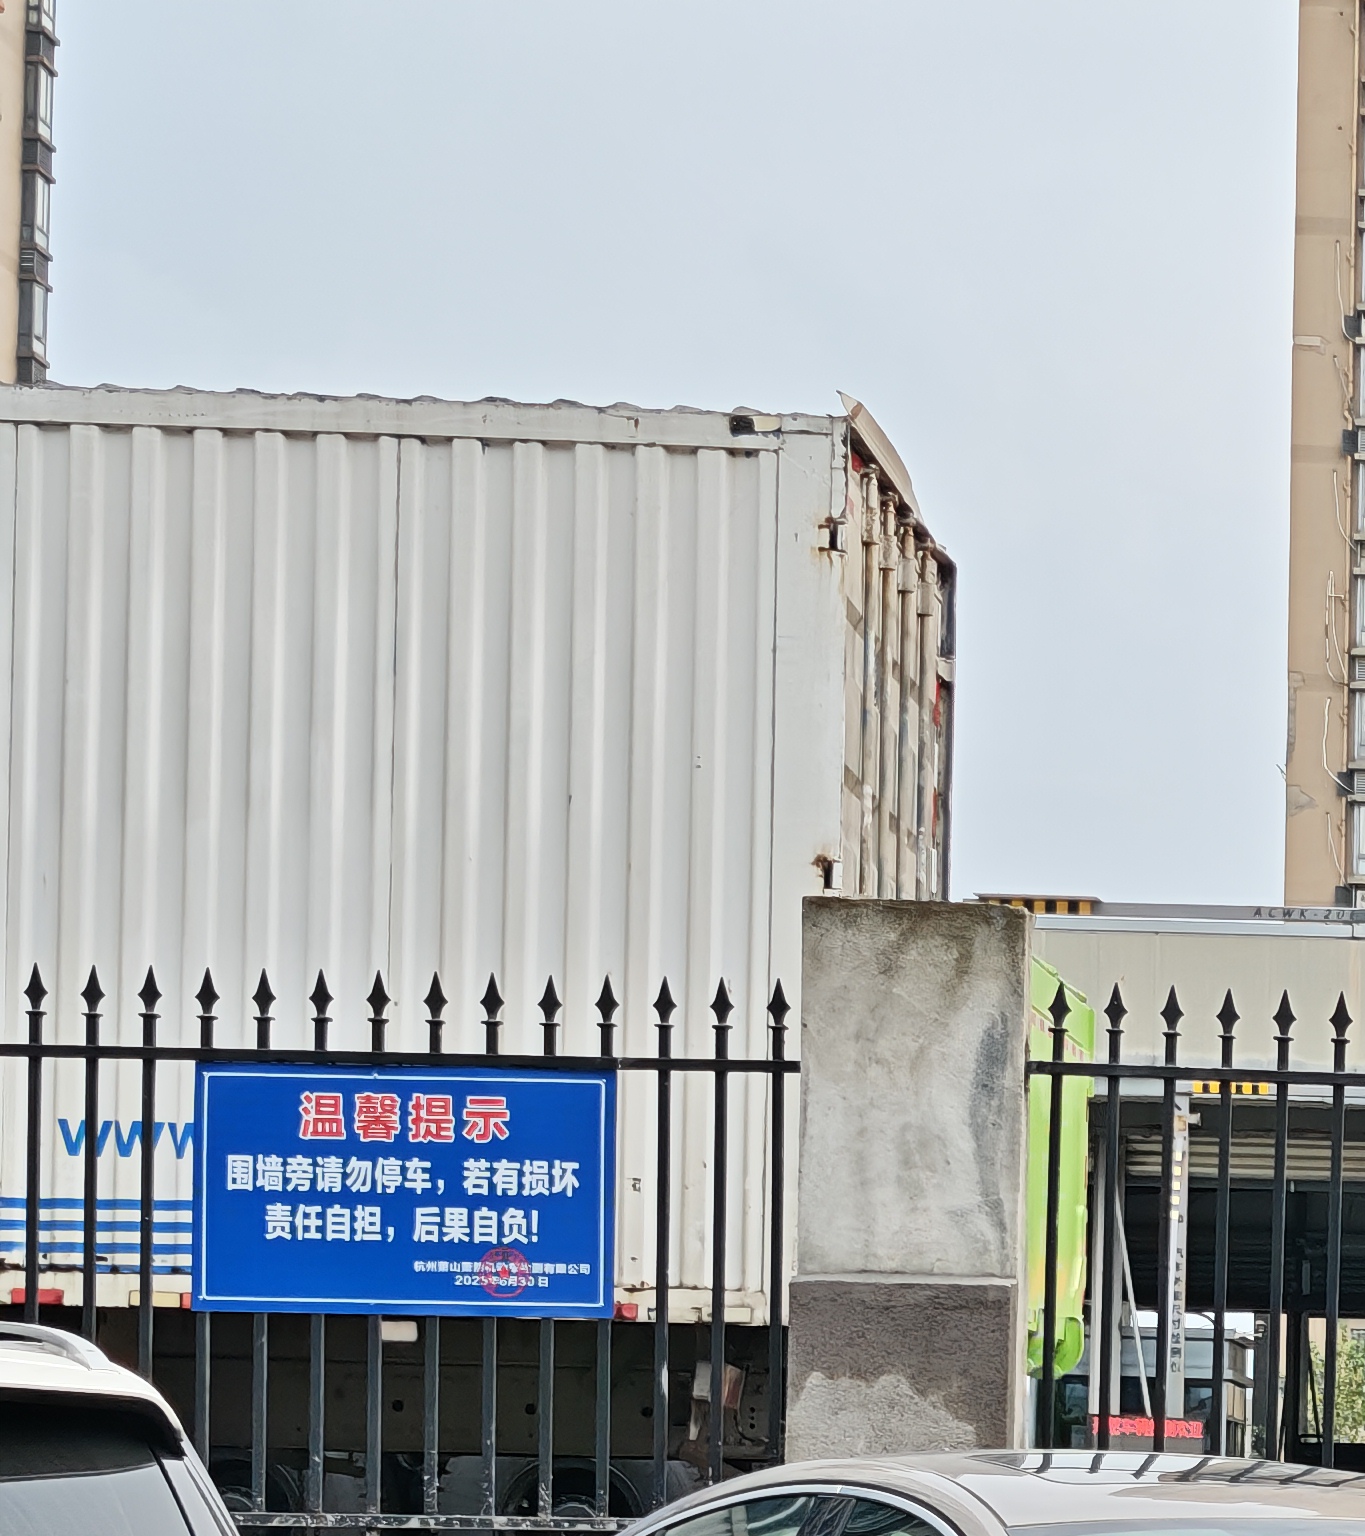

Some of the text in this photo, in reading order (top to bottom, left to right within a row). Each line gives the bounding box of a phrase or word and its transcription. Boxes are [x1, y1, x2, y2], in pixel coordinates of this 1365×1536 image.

[299, 1091, 511, 1144] 温馨提示
[226, 1154, 581, 1198] 围墙旁请勿停车，若有损坏
